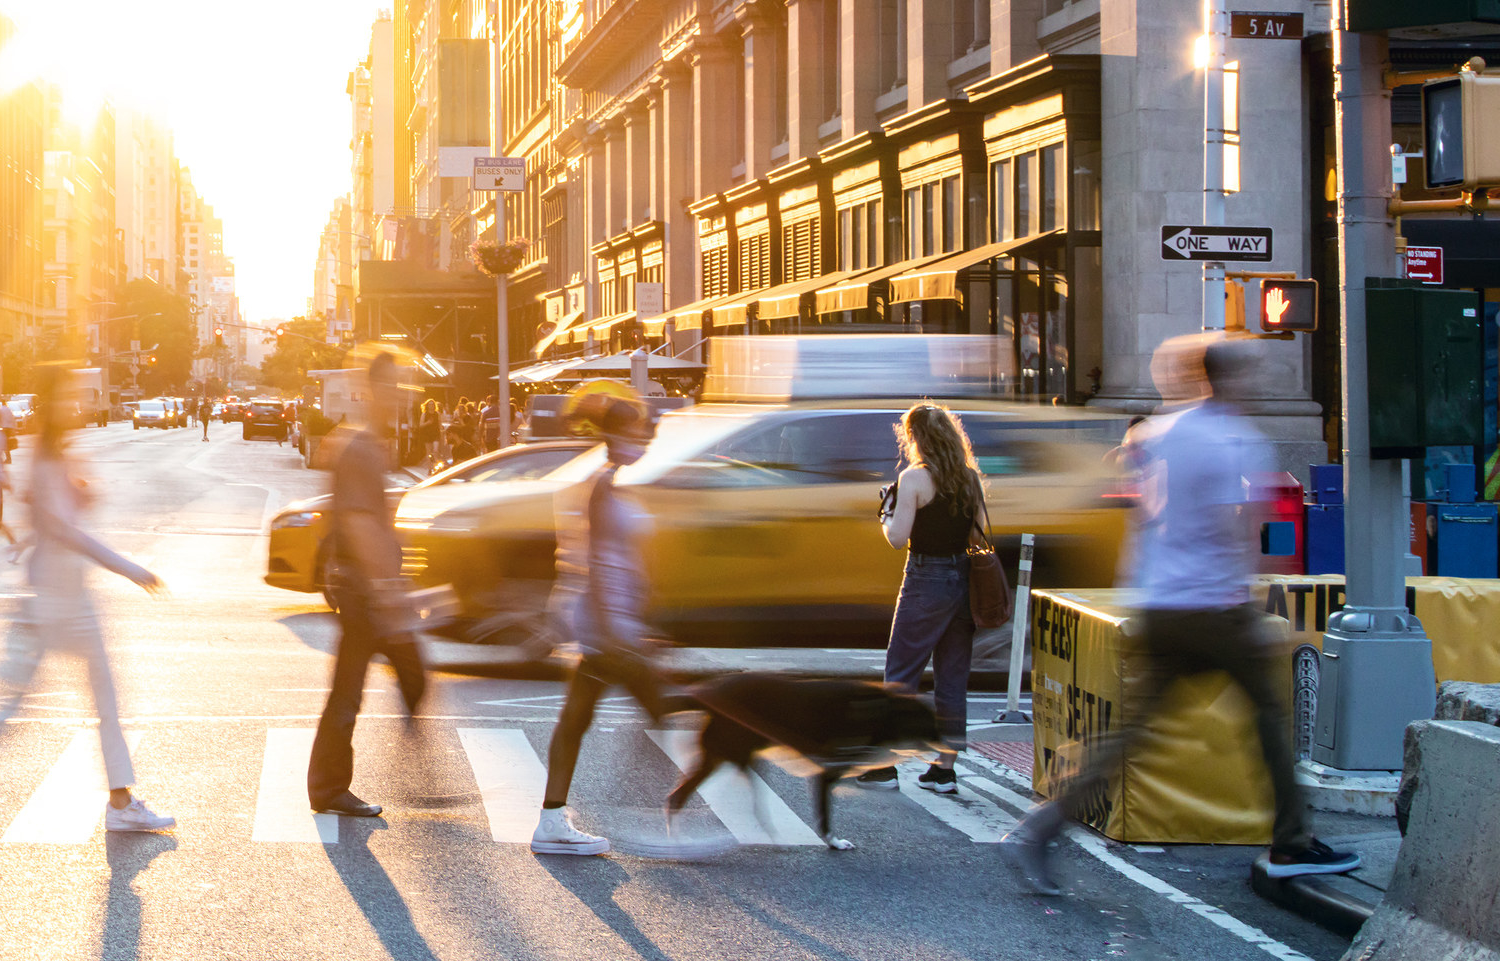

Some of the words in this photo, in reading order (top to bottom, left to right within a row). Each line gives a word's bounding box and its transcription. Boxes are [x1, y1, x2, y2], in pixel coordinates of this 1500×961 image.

[1249, 18, 1258, 36] 5
[1264, 19, 1284, 37] Av
[476, 167, 501, 175] BUSES
[1176, 236, 1209, 250] ONE
[1227, 237, 1263, 251] WAY
[1407, 250, 1414, 258] NO
